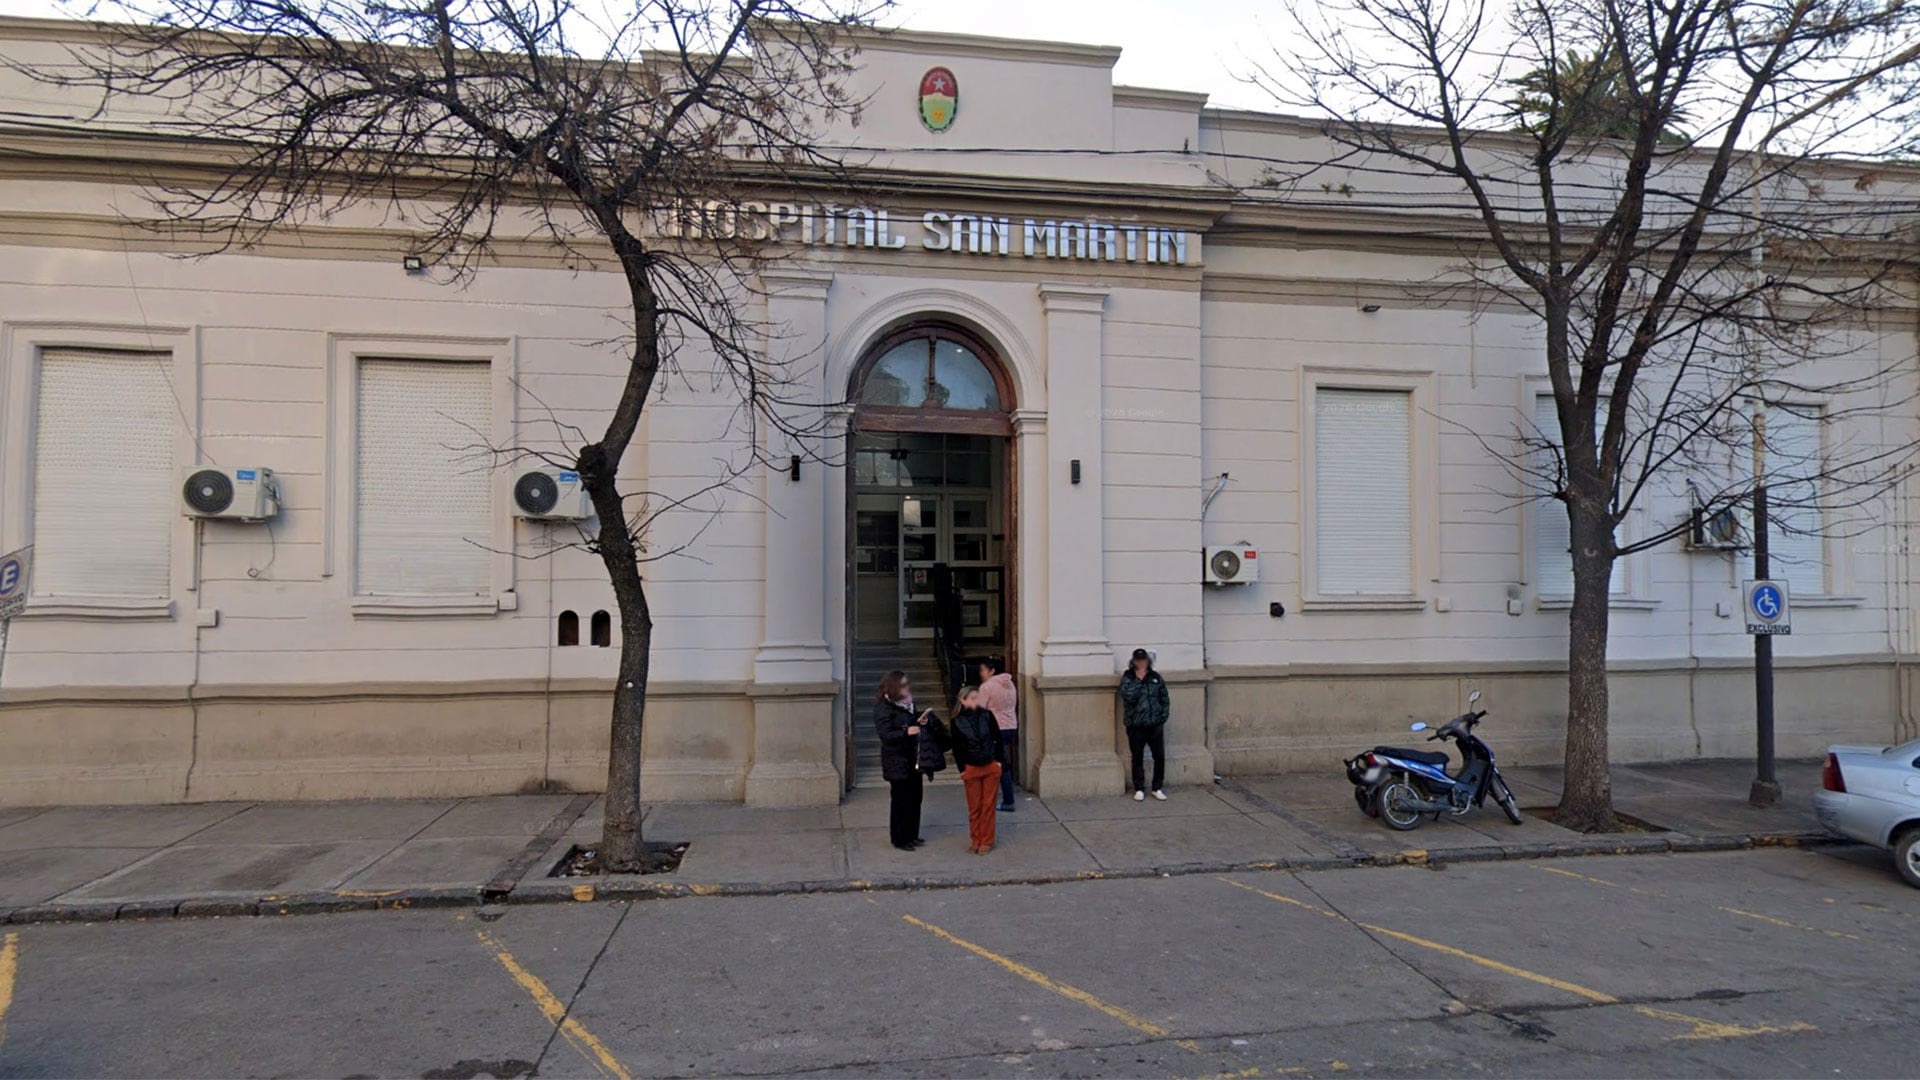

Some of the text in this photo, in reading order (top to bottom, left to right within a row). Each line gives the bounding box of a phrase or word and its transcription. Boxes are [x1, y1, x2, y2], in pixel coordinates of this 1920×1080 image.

[671, 198, 1185, 265] HOSPITAL SAN MARTIN
[1, 563, 18, 592] E
[1746, 624, 1791, 634] EXCLUSIVO
